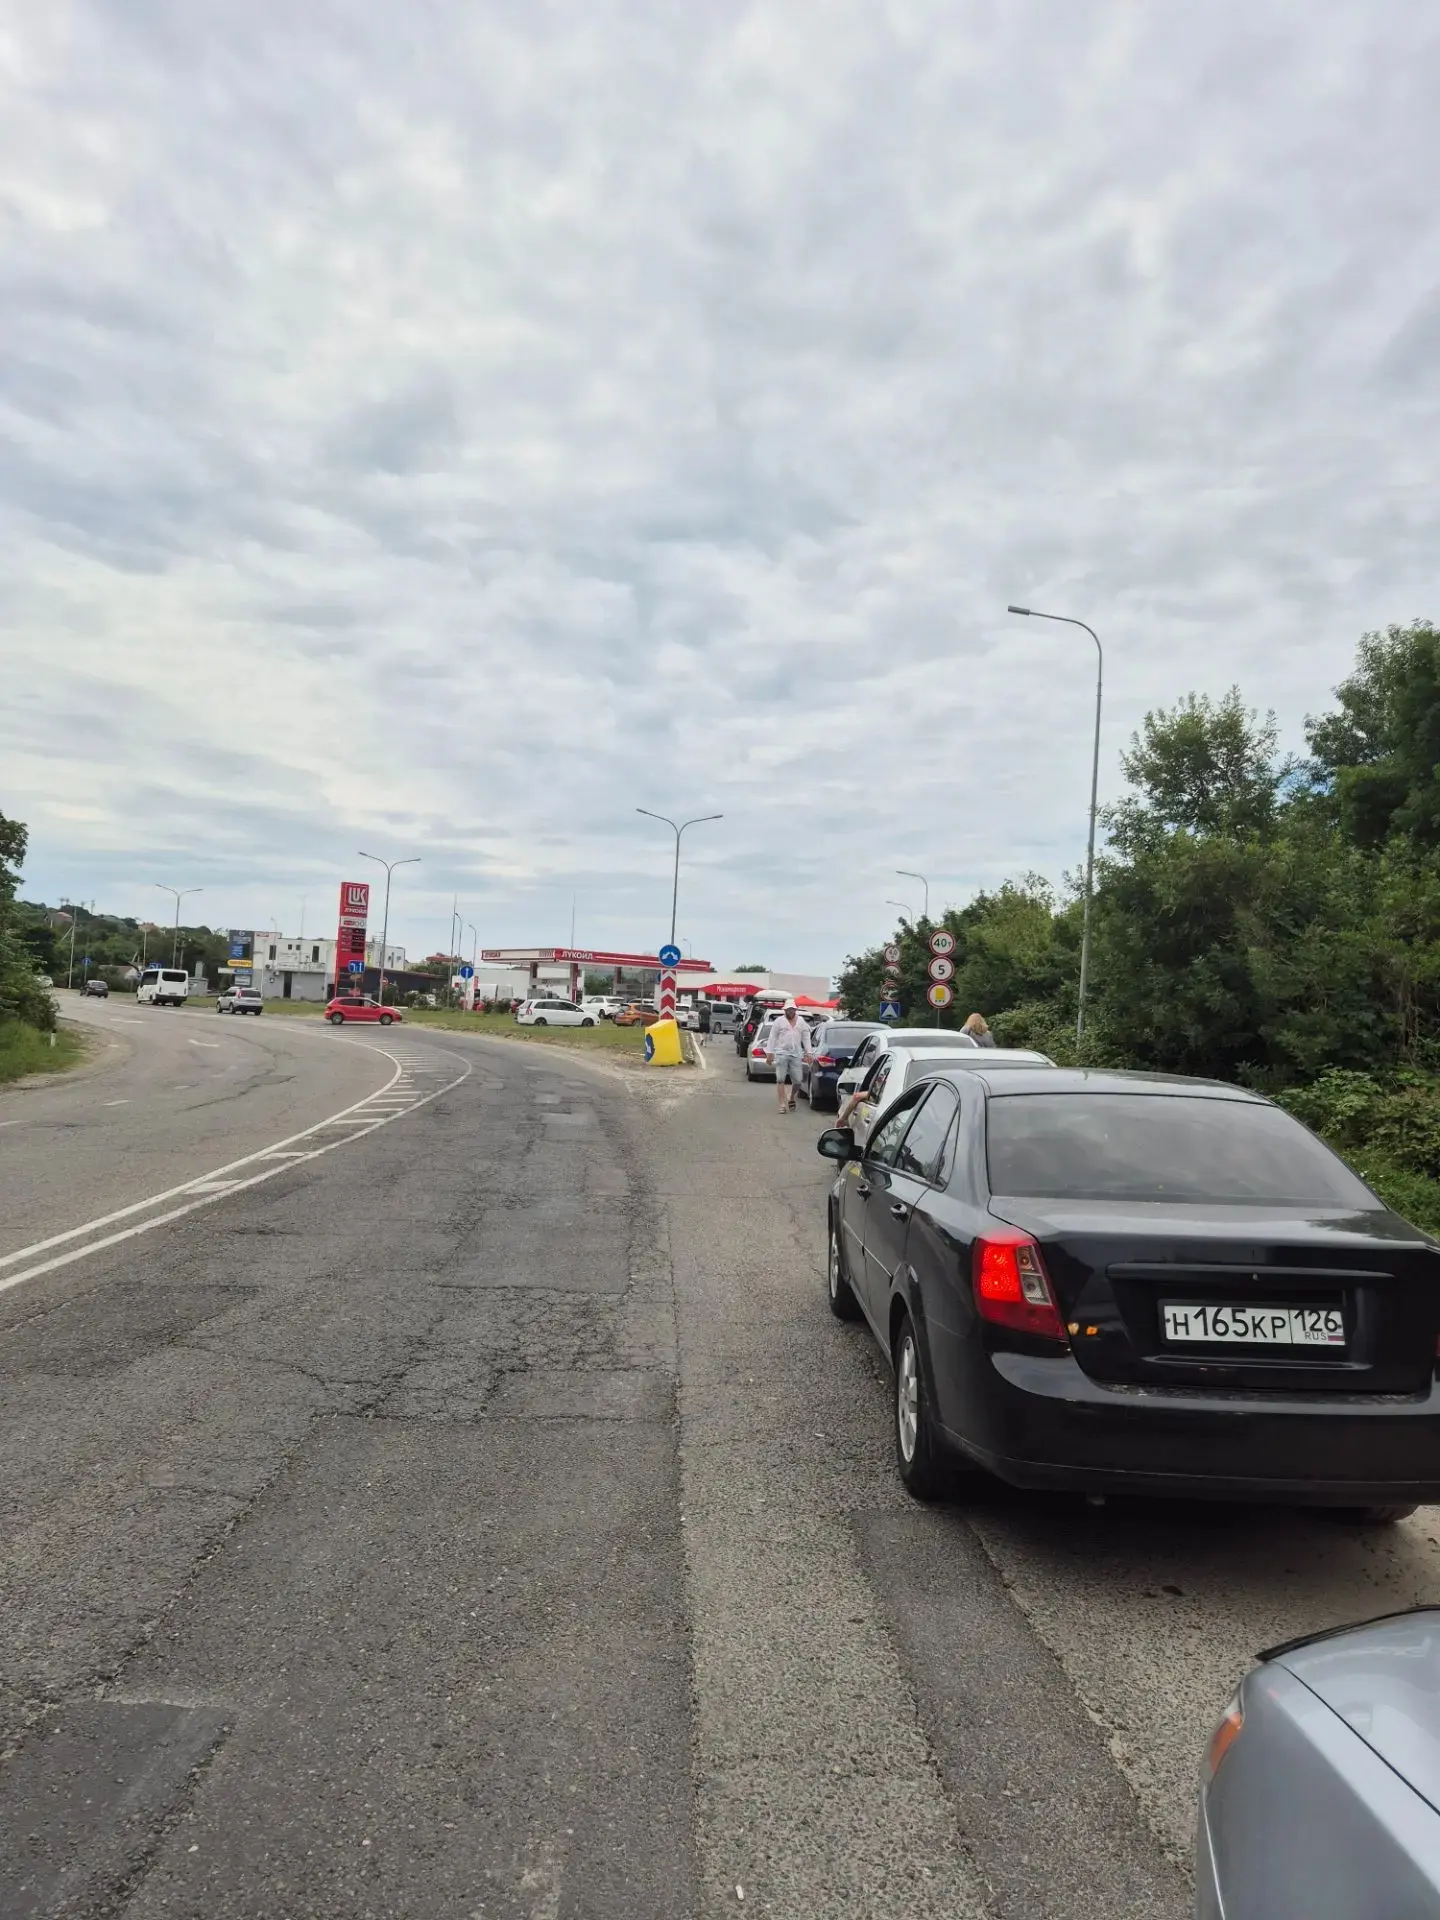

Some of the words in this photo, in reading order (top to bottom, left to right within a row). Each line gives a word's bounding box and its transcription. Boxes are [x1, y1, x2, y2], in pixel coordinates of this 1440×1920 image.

[938, 965, 945, 975] 5
[1294, 1310, 1338, 1332] 126
[1304, 1331, 1328, 1341] RUS
